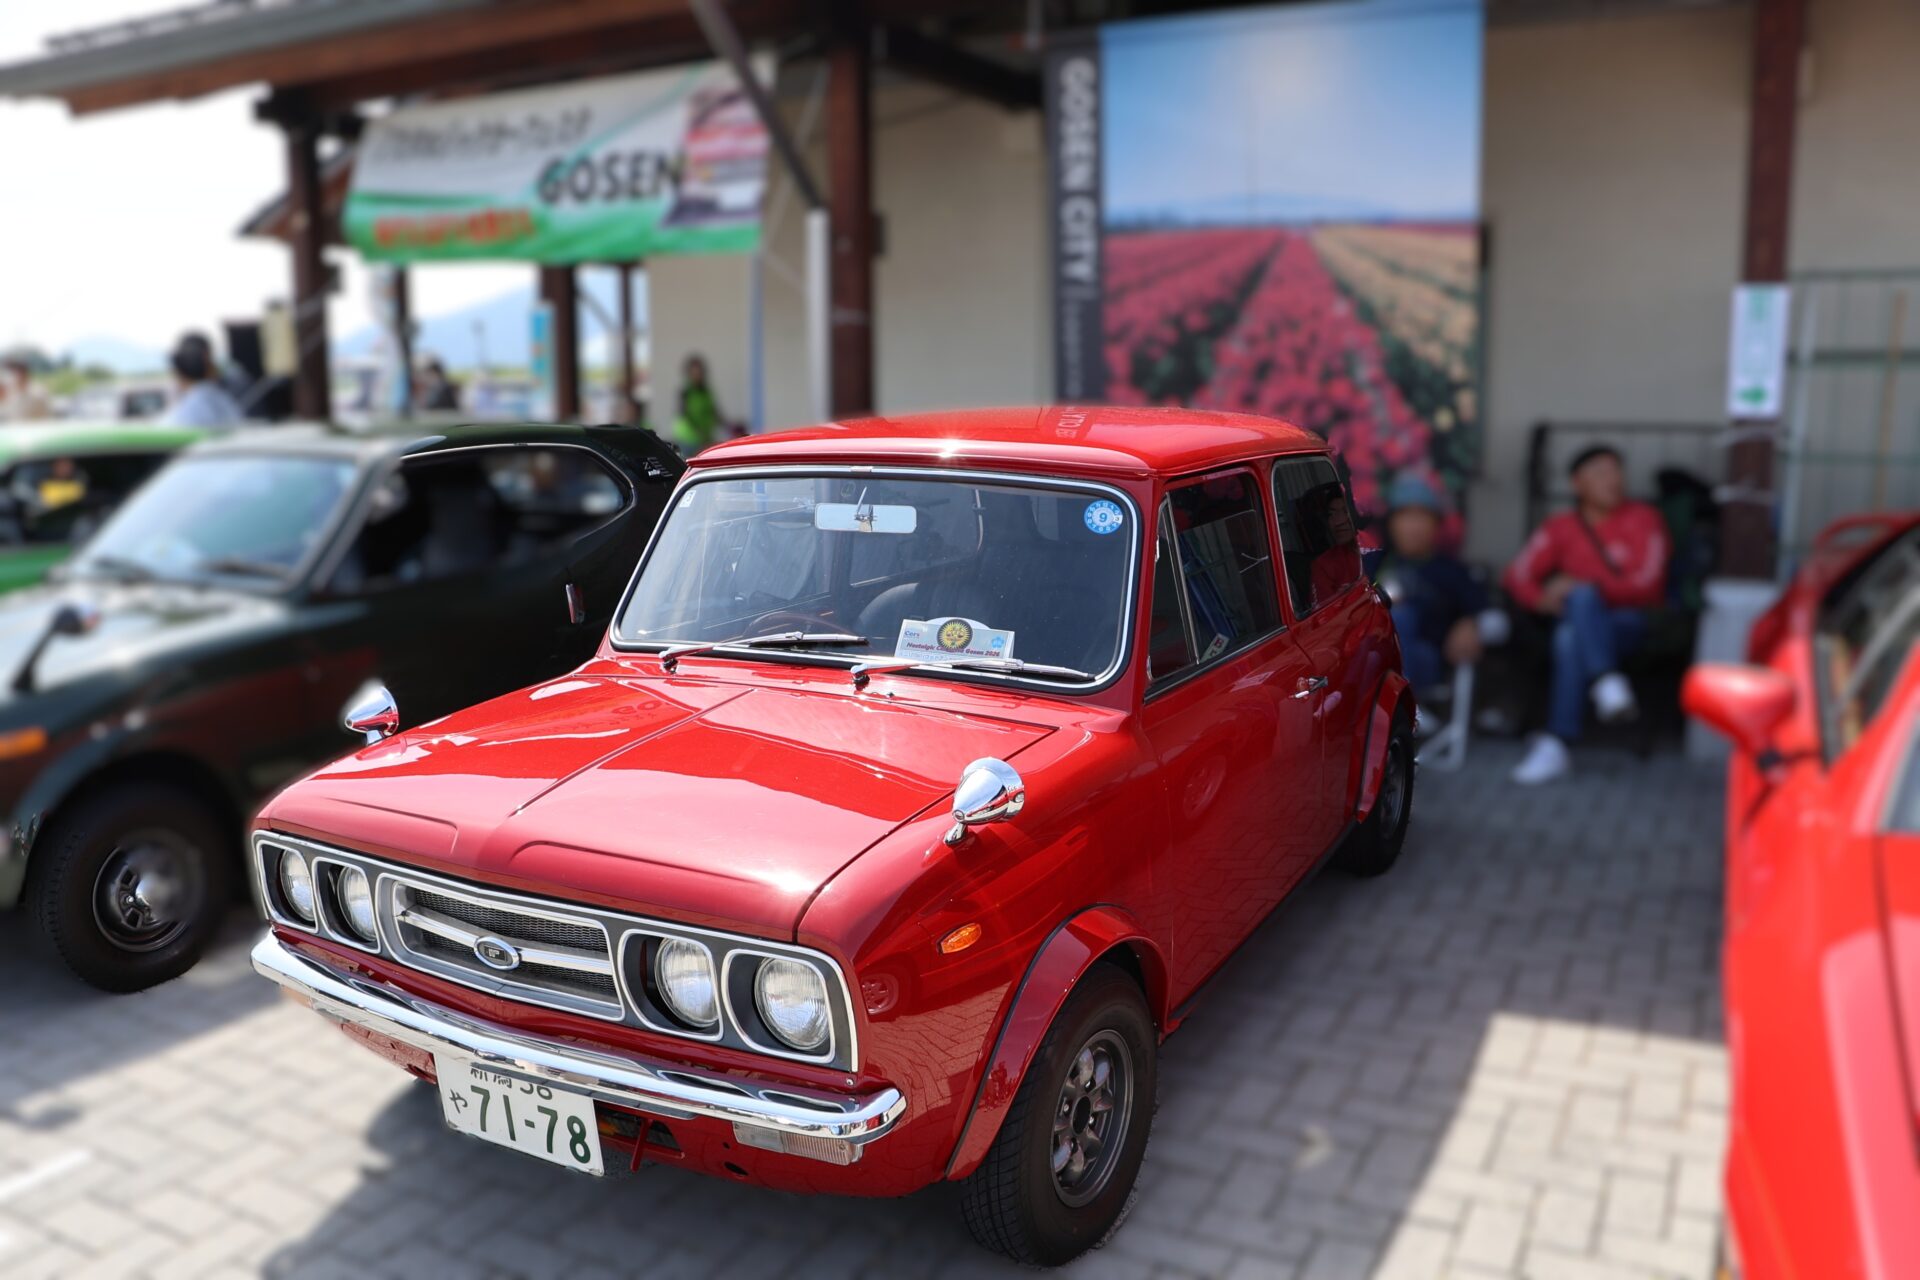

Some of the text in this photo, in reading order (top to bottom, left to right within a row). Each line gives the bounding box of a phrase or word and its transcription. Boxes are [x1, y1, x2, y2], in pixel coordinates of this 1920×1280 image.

[1060, 57, 1096, 189] GOSEN
[537, 146, 683, 203] GOSEN
[1060, 197, 1096, 283] CITY
[1099, 512, 1107, 522] 9
[449, 1085, 591, 1164] や 71-78
